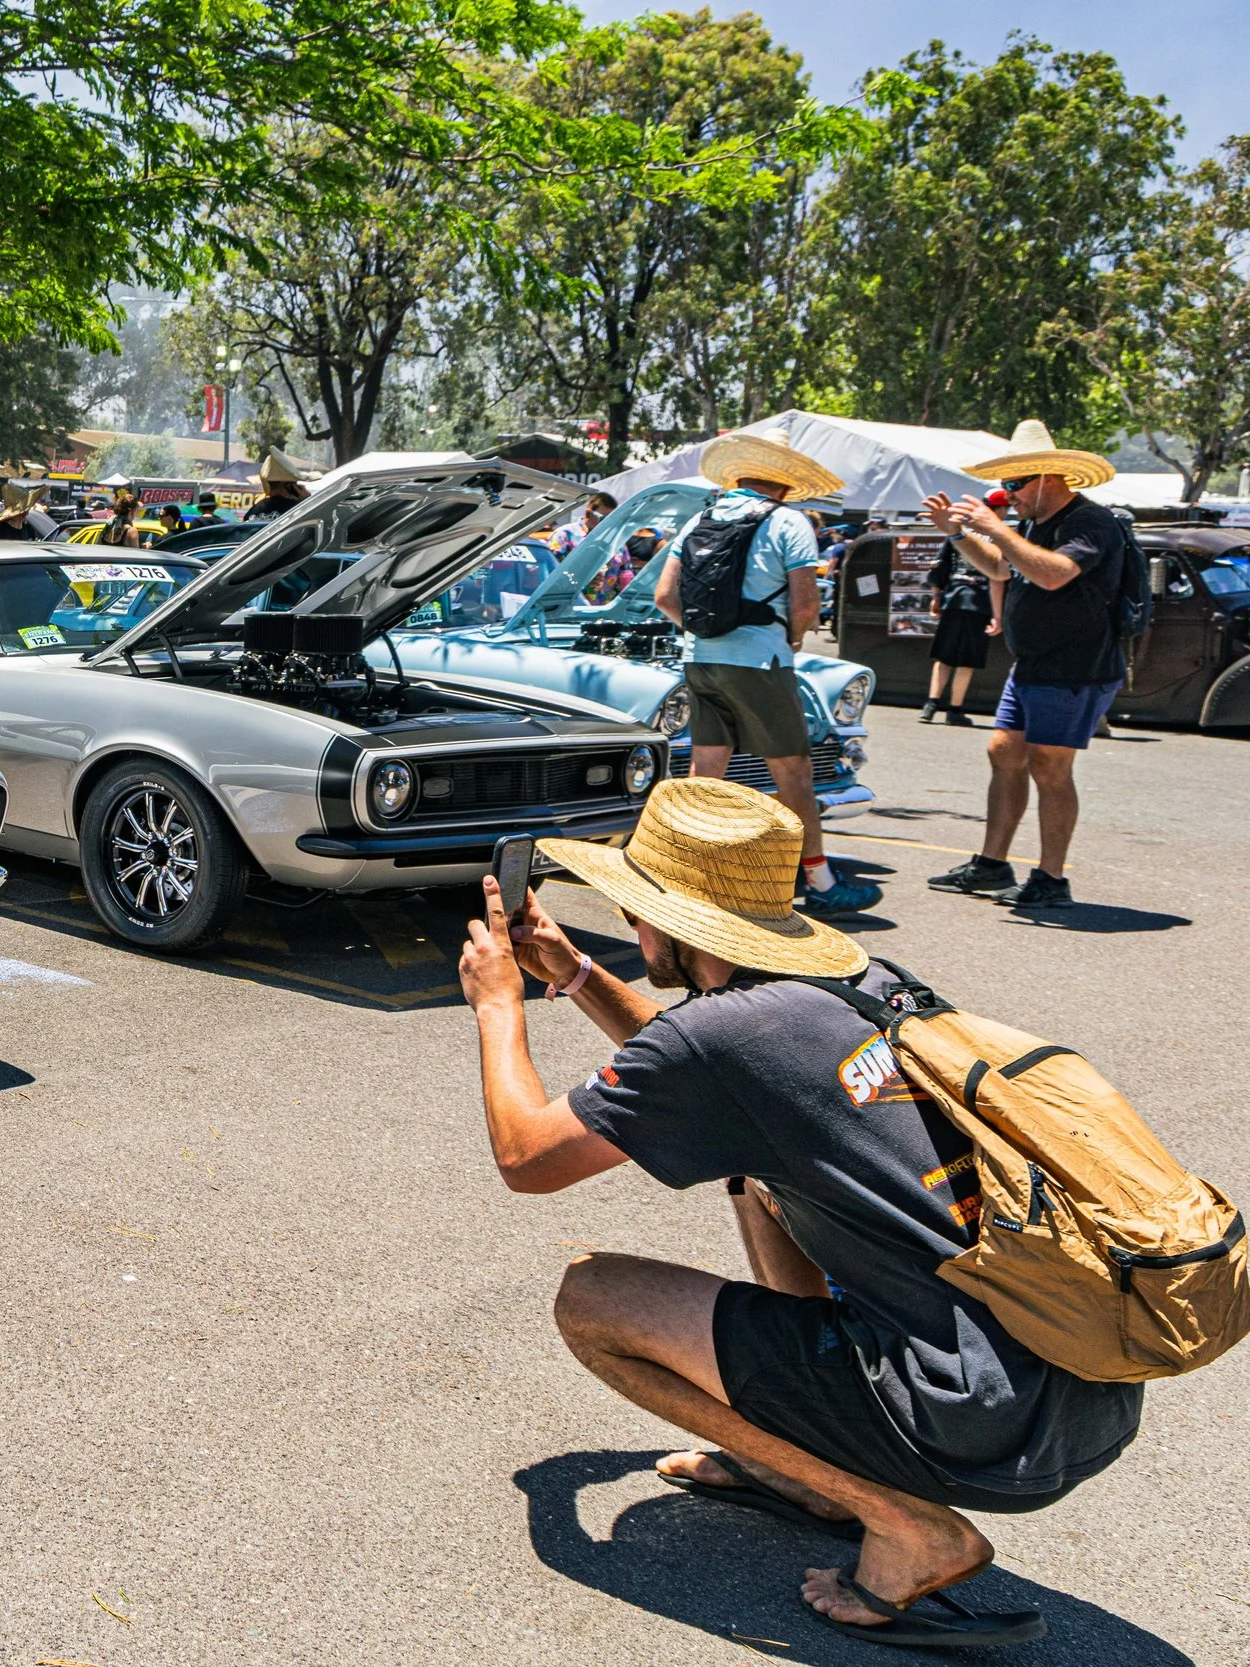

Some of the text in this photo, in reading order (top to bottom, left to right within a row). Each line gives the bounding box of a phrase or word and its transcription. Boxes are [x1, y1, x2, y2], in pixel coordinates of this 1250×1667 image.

[126, 567, 166, 579] 1276
[410, 612, 437, 624] 0848
[32, 635, 58, 646] 1276
